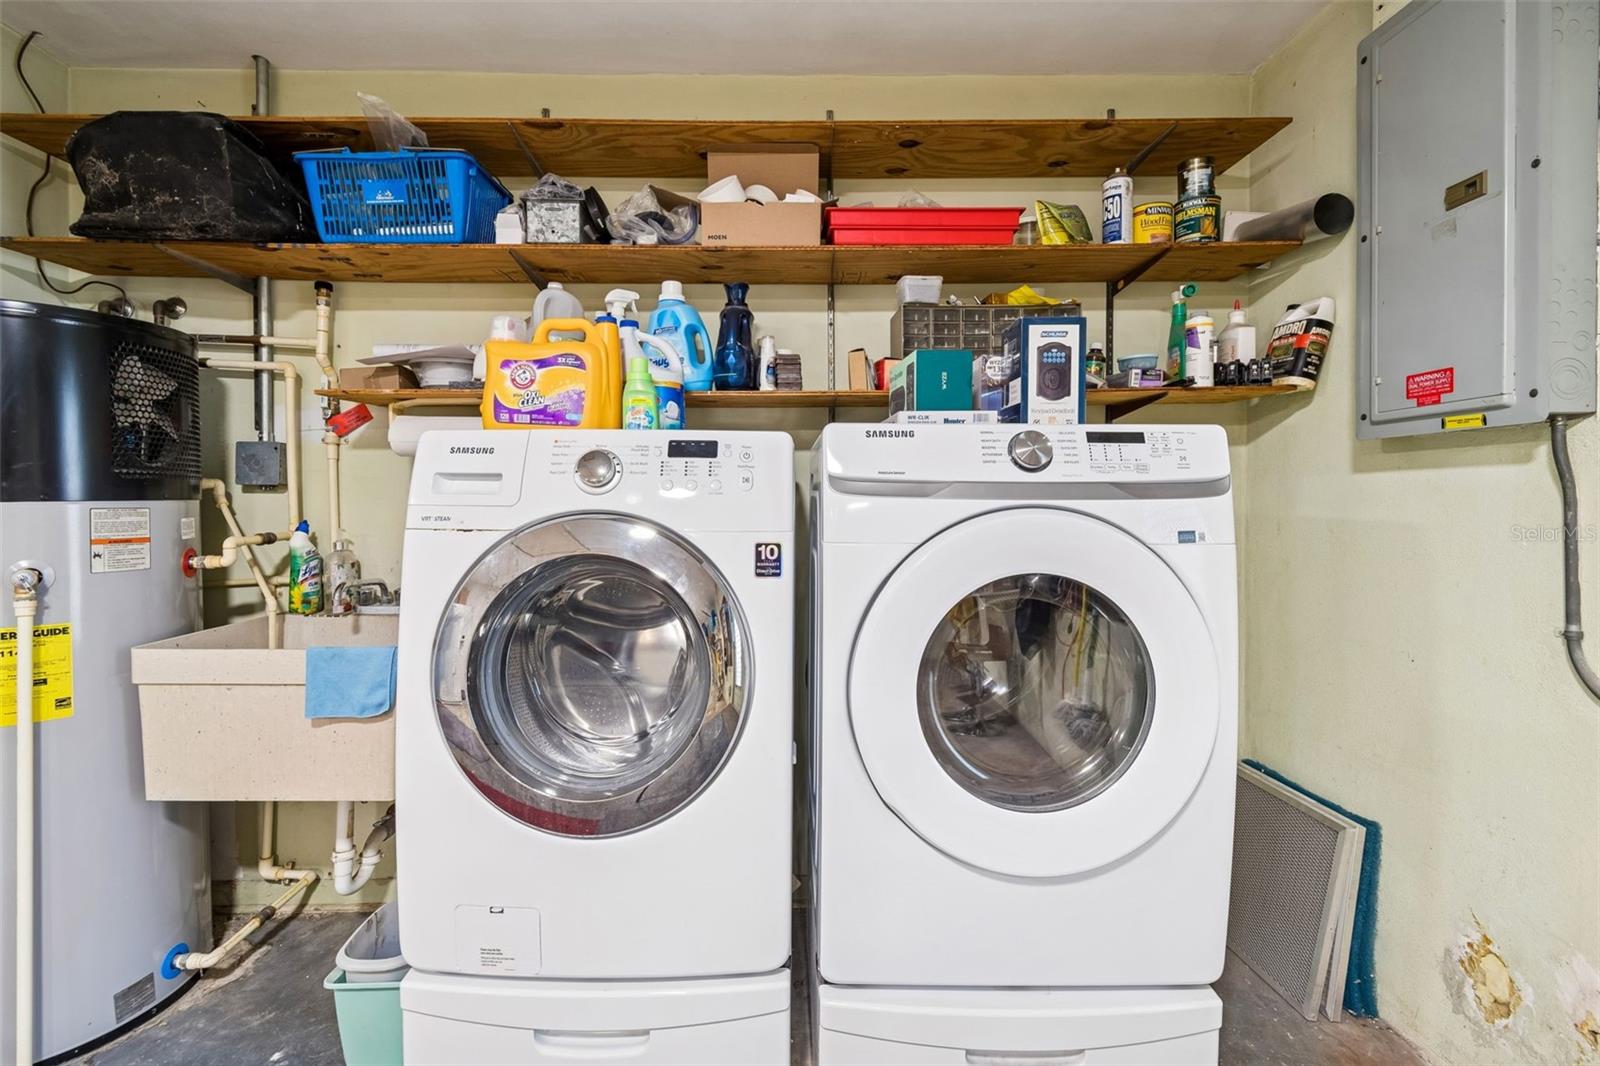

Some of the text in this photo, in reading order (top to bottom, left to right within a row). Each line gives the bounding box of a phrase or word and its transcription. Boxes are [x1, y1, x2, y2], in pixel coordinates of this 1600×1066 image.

[1273, 320, 1307, 340] AMDRO
[1414, 371, 1445, 382] WARNING
[524, 391, 539, 399] OXI
[519, 396, 545, 407] CLEAN
[865, 430, 915, 438] SAMSUNG
[449, 446, 495, 455] SAMSUNG
[757, 544, 779, 560] 10
